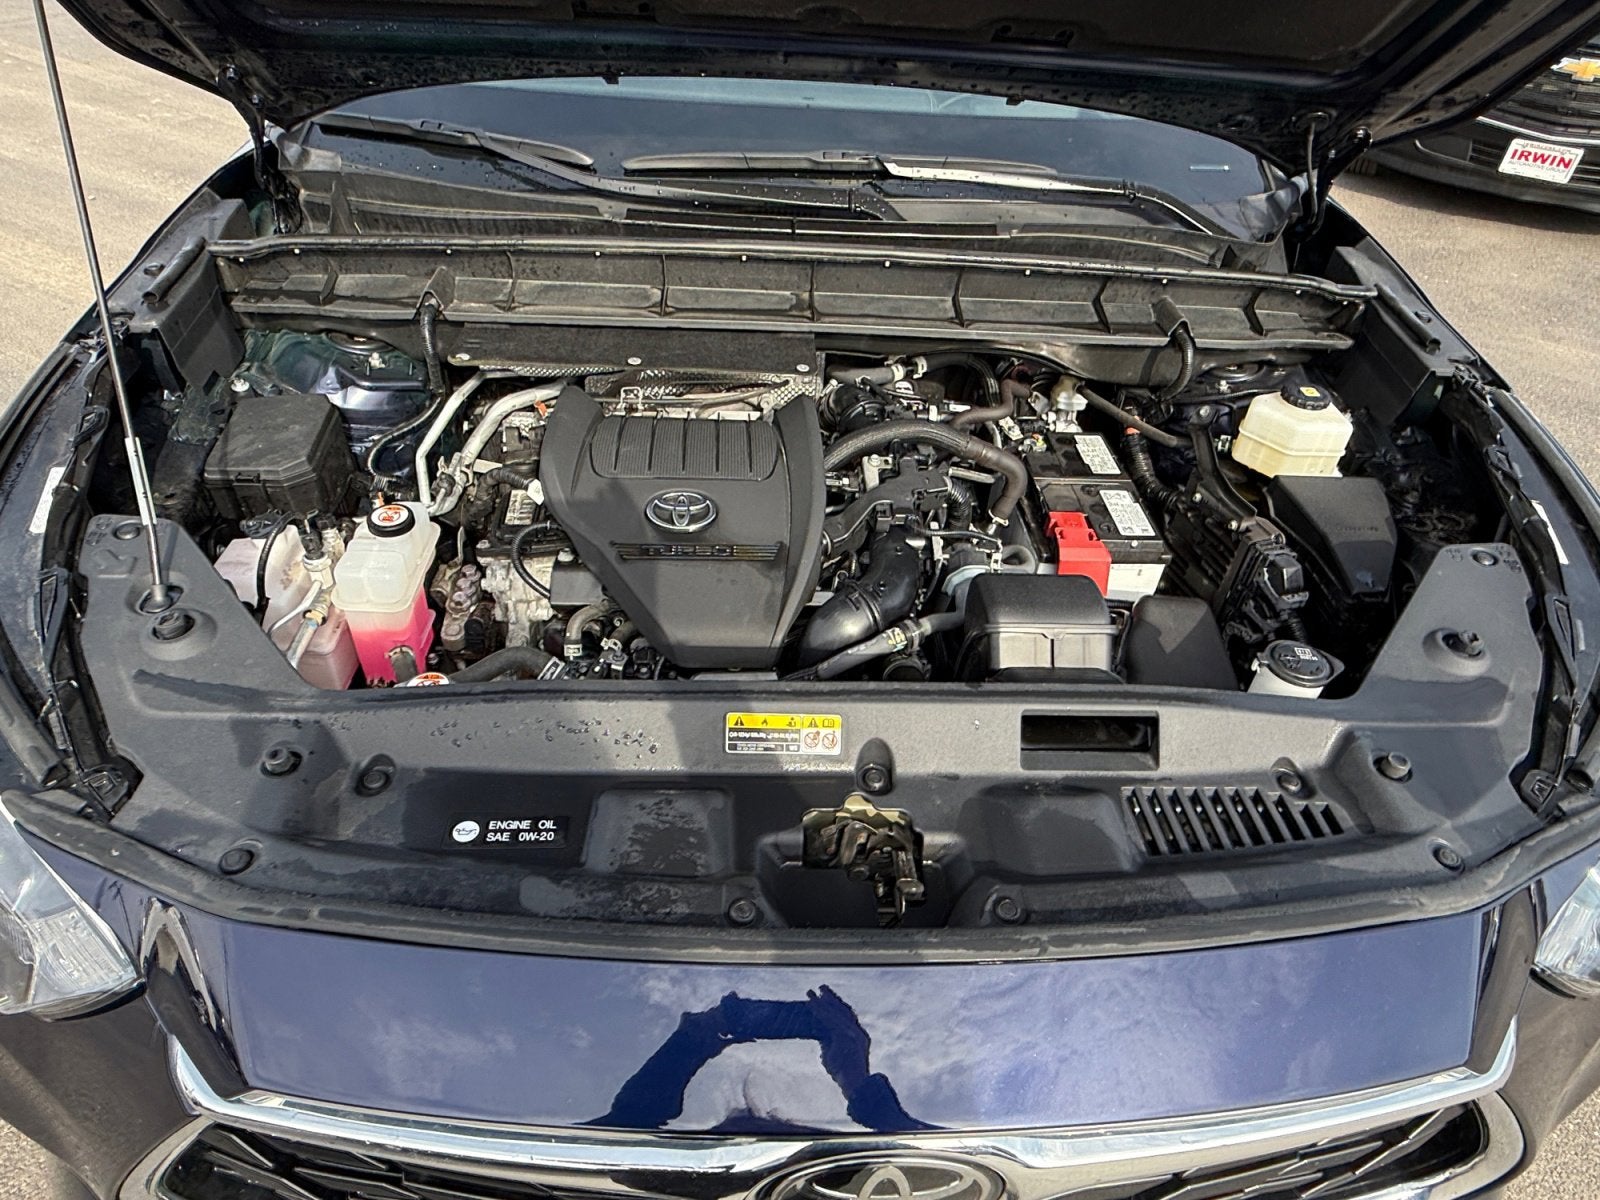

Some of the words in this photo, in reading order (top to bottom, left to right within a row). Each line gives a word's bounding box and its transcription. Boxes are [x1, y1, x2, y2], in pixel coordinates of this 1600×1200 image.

[1510, 148, 1573, 169] IRWIN
[488, 820, 531, 830] ENGINE
[538, 820, 557, 829] OIL
[486, 832, 511, 842] SAE
[518, 832, 555, 842] 0W-20
